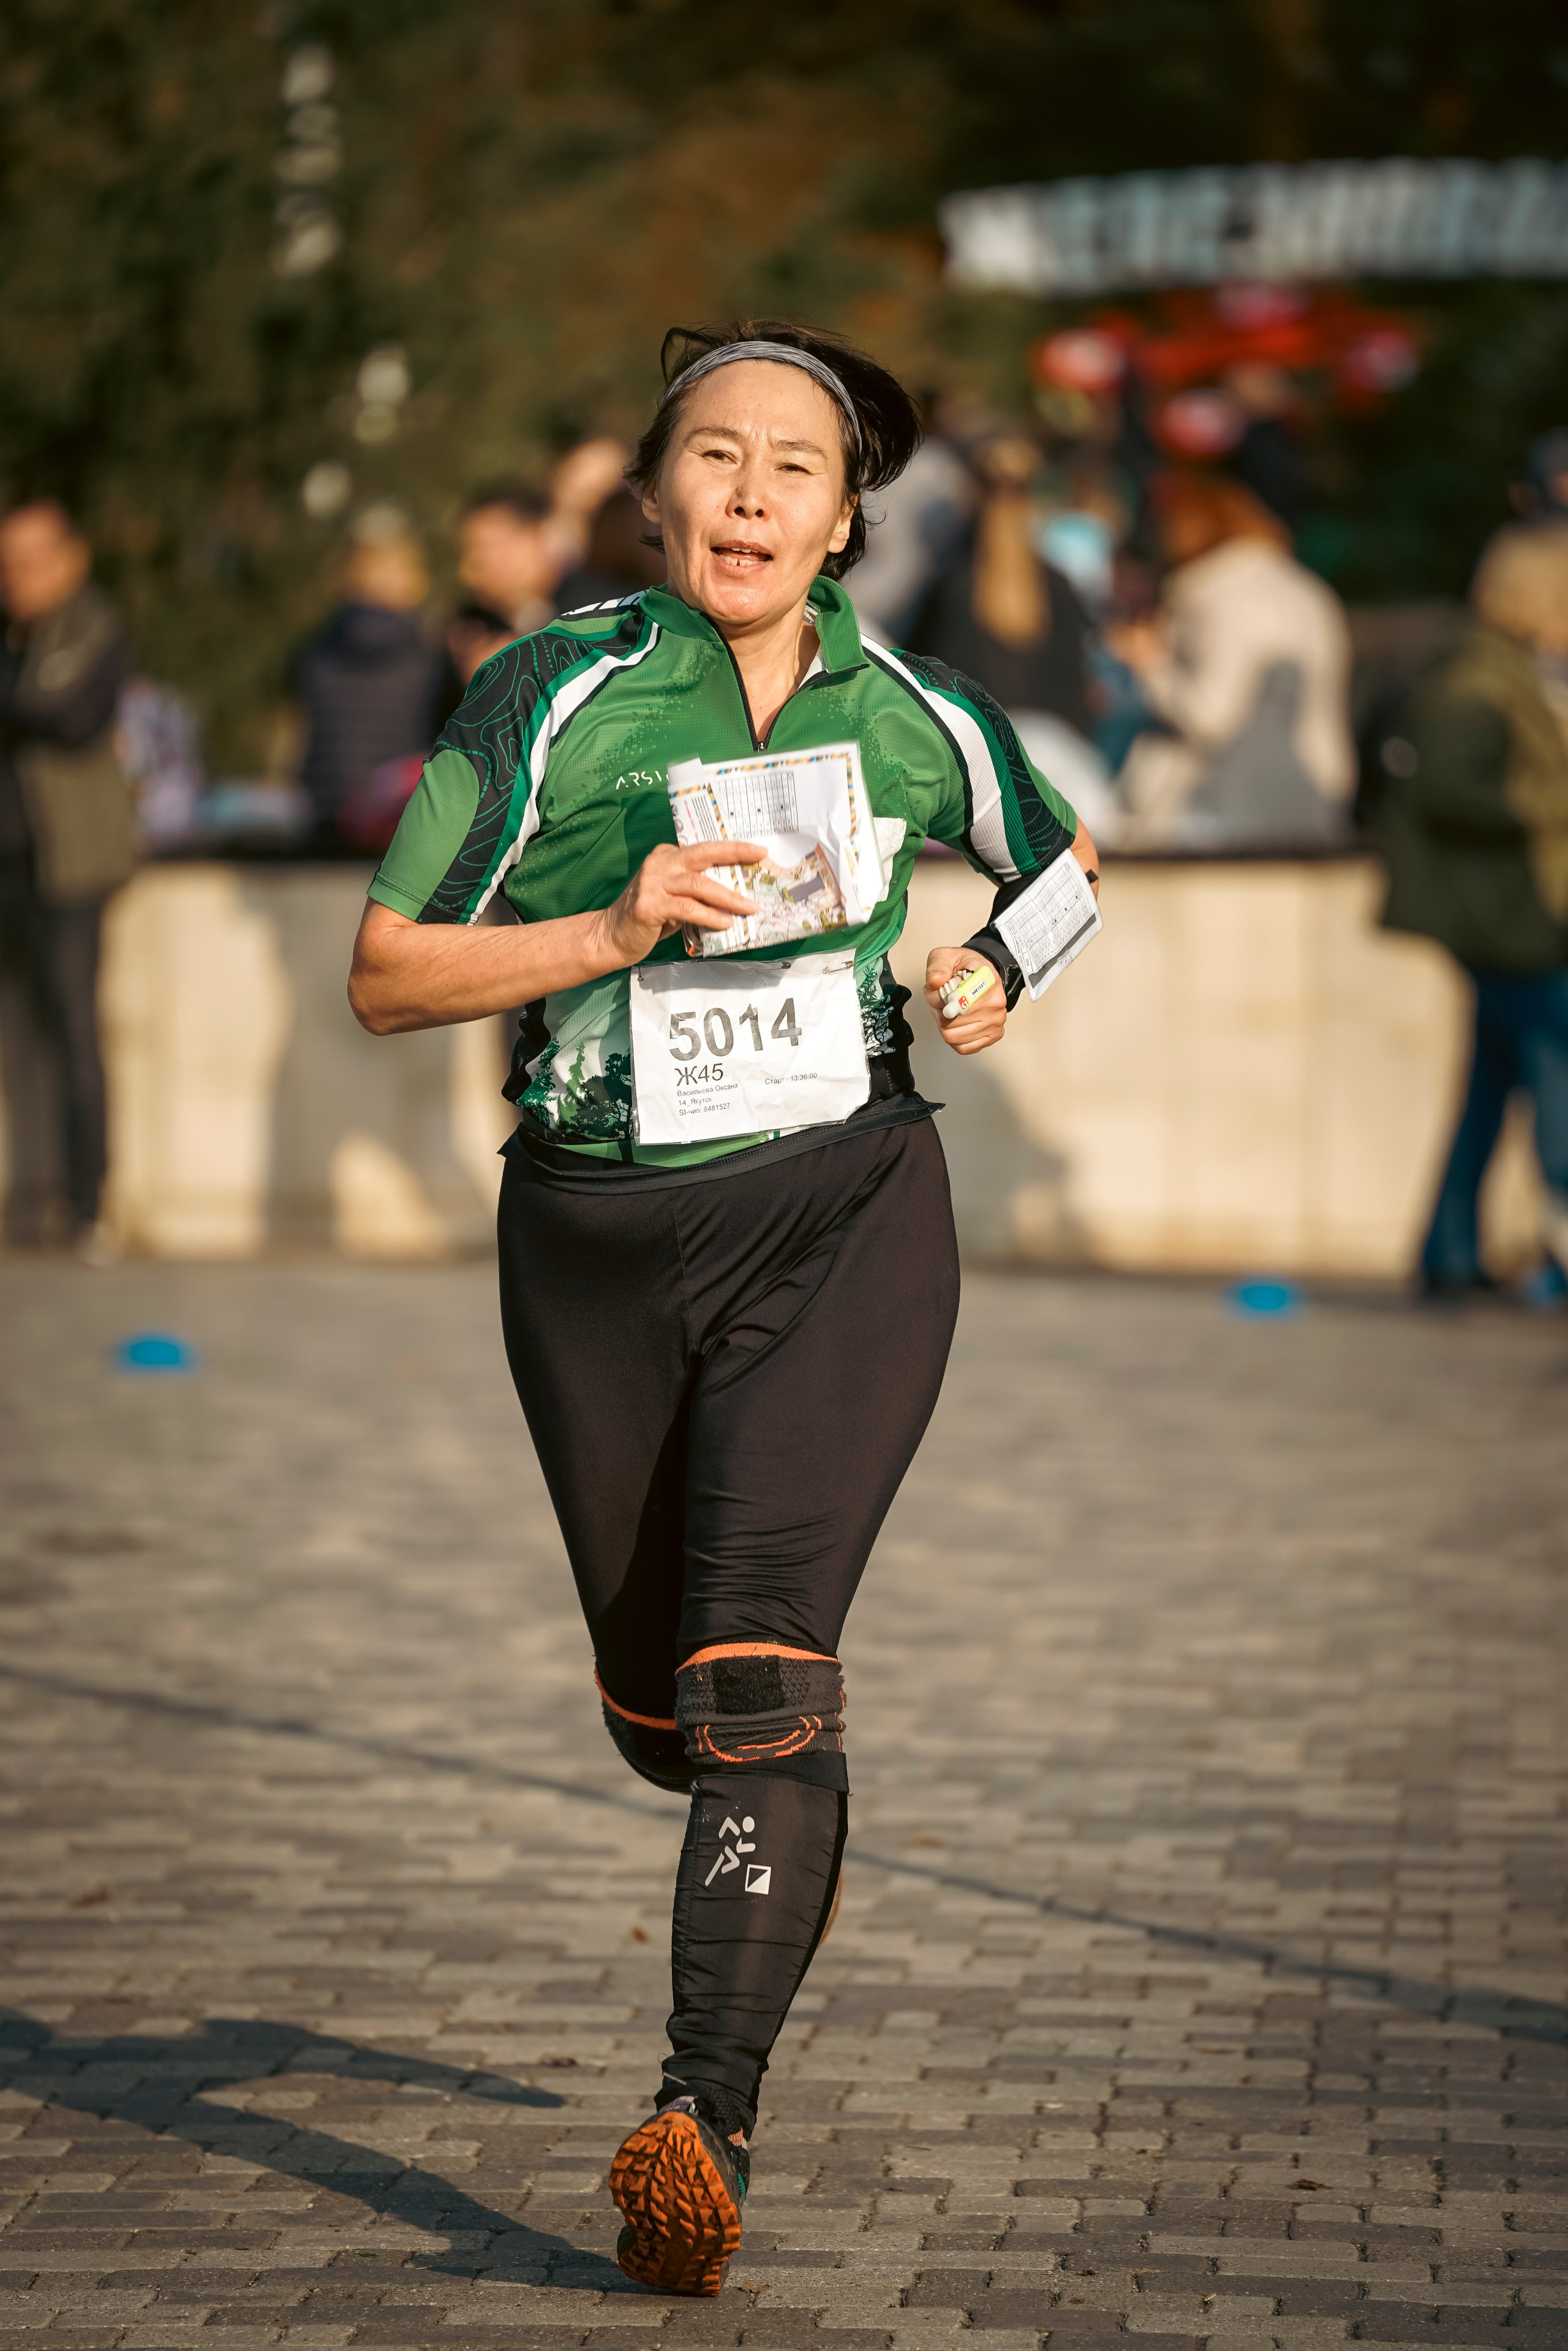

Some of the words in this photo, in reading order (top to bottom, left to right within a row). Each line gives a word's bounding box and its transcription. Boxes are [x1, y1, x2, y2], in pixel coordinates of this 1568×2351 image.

[669, 997, 802, 1062] 5014
[674, 1063, 723, 1087] Ж45
[790, 1072, 818, 1081] 13:36:00
[677, 1087, 714, 1097] Васильева
[715, 1083, 739, 1092] Оксана
[678, 1097, 712, 1107] 14_Якутск
[703, 1102, 731, 1112] 8481527
